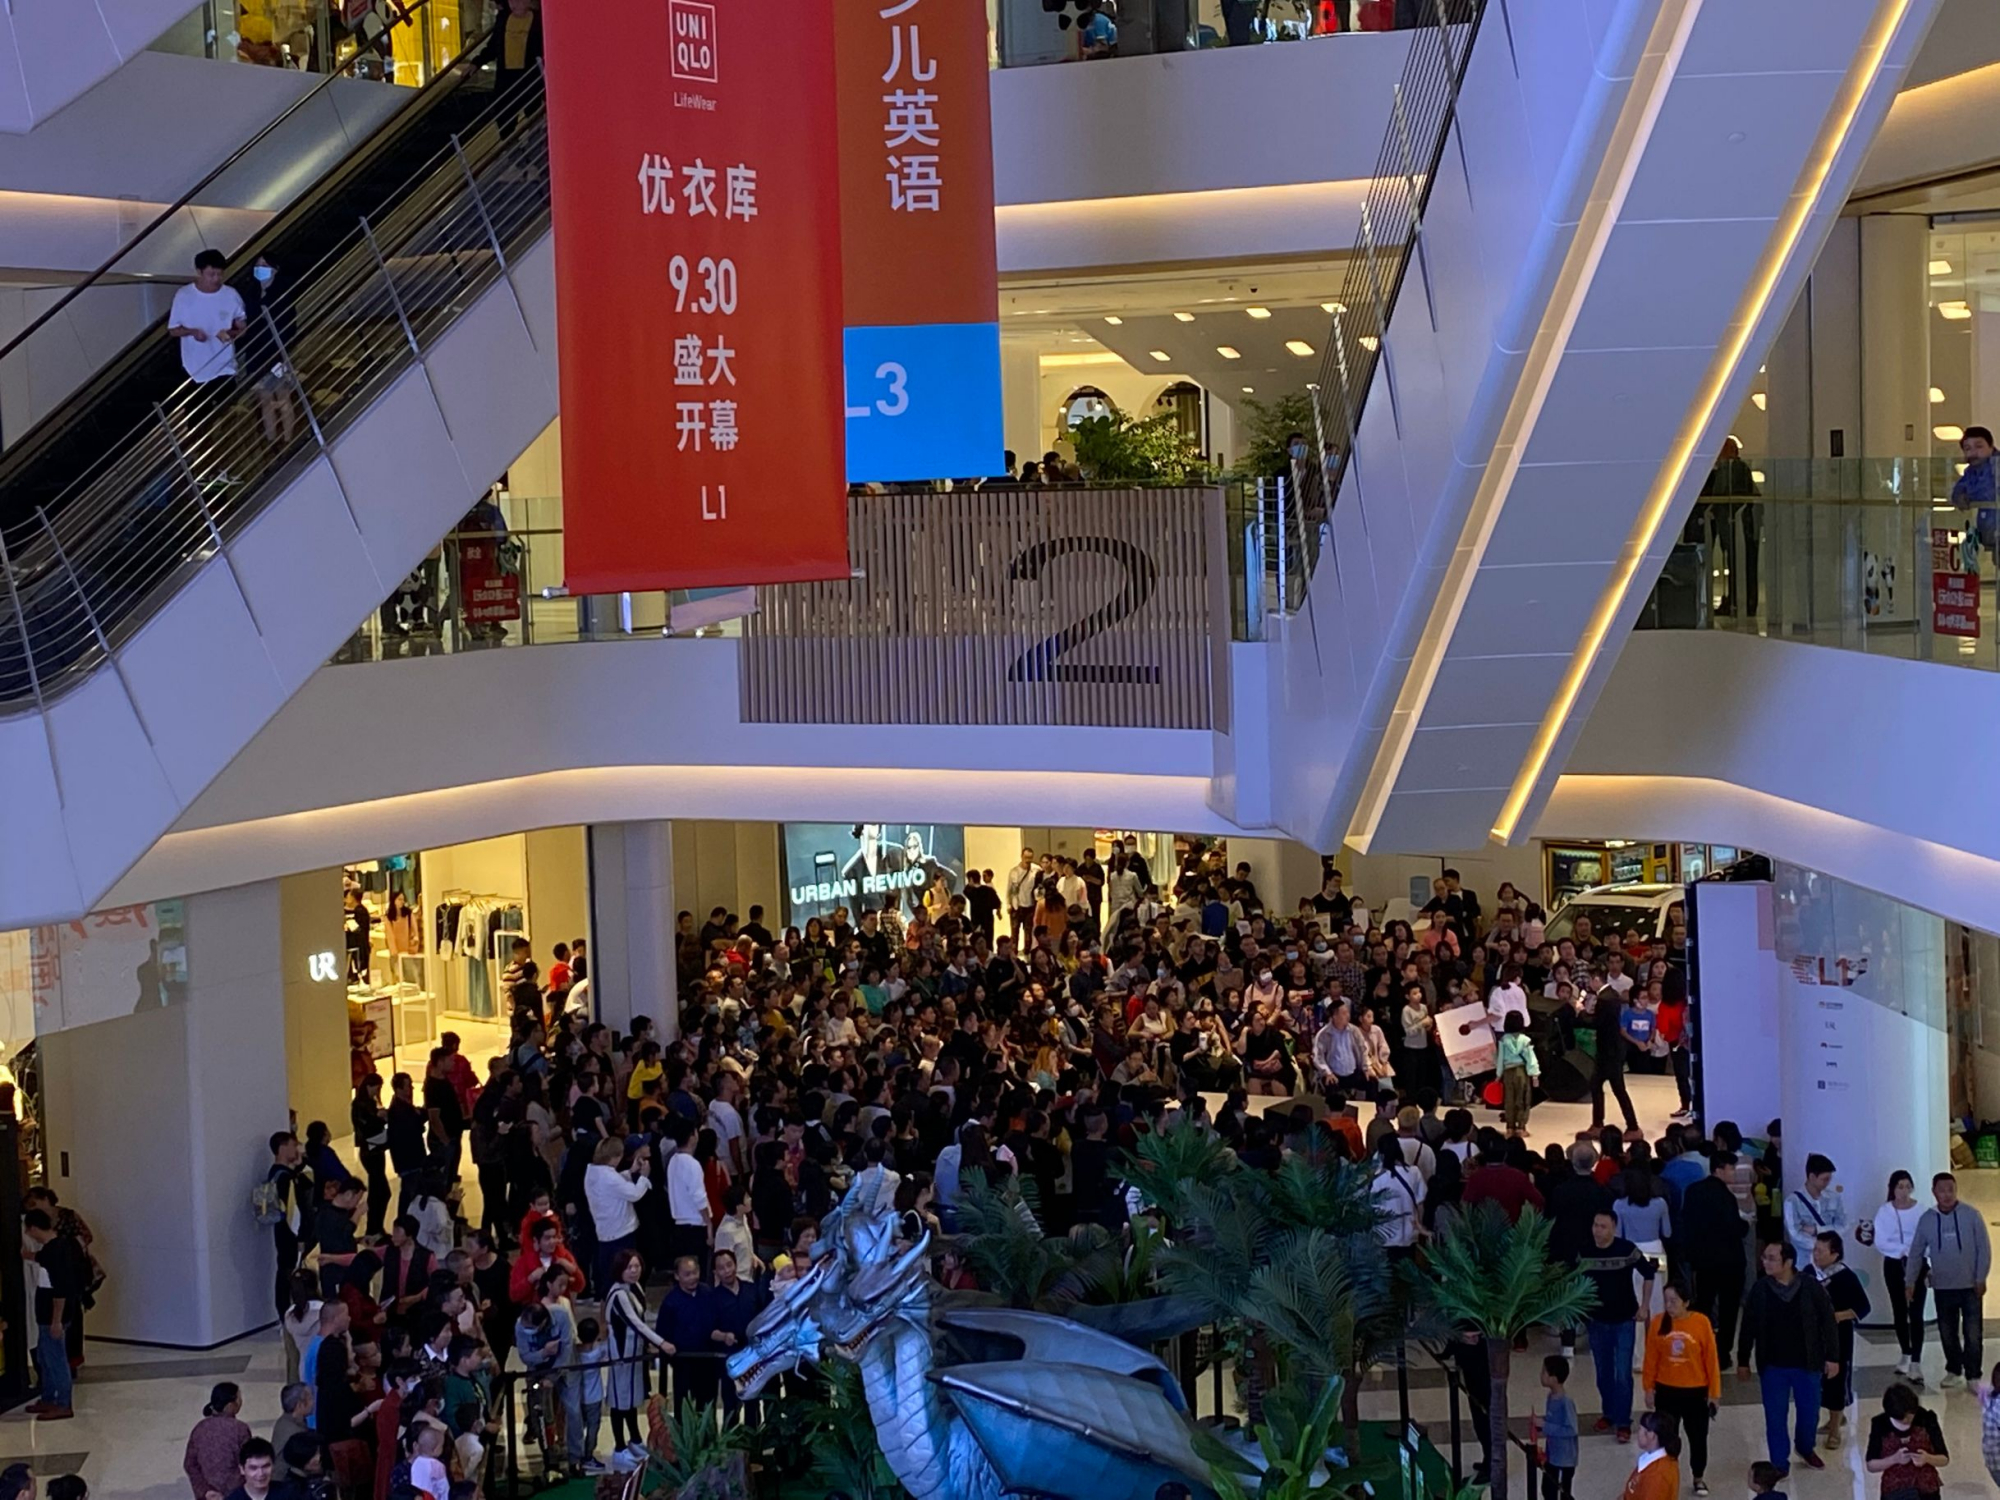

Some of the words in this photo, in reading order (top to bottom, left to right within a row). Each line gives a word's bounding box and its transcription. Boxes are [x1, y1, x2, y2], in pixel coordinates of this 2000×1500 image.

[675, 11, 707, 40] UNI
[677, 42, 711, 72] QLO
[673, 91, 718, 111] LifeWear
[880, 0, 942, 212] 儿英语
[637, 153, 758, 222] 优衣库
[669, 255, 738, 315] 9.30
[674, 333, 737, 386] 盛大
[675, 399, 739, 452] 开幕
[702, 485, 726, 520] L1
[1006, 536, 1158, 684] 2
[791, 879, 857, 905] URBAN
[862, 868, 926, 895] REVIVO
[308, 950, 340, 983] UR
[1818, 957, 1848, 987] L1
